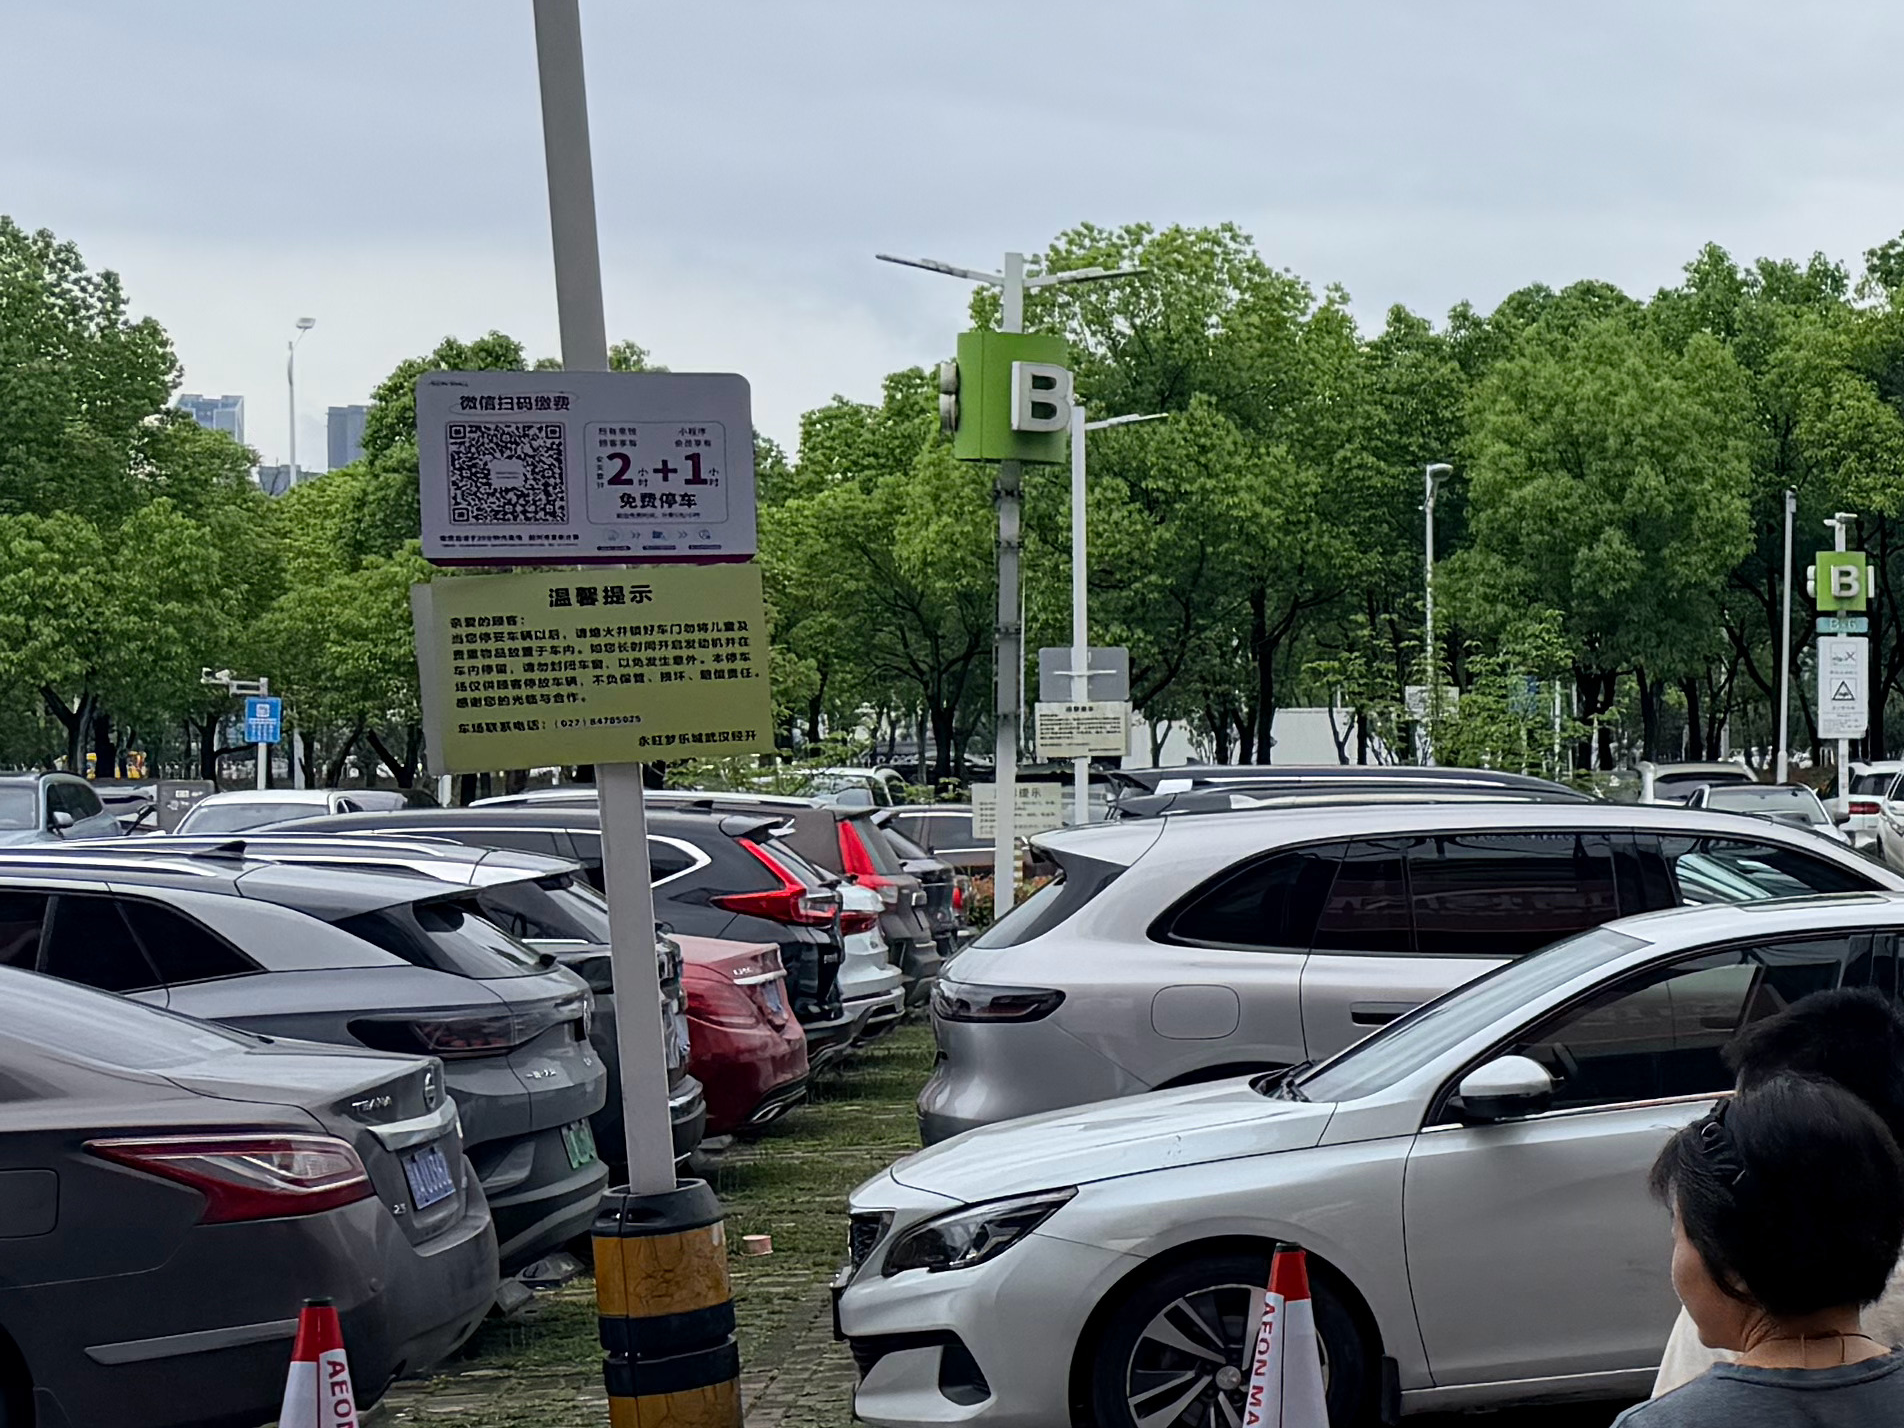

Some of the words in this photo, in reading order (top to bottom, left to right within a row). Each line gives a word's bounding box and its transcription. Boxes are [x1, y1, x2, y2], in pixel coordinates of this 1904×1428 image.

[1011, 361, 1074, 432] B
[619, 492, 698, 509] 免费停车
[549, 584, 653, 607] 温馨提示
[1830, 564, 1861, 598] B
[1252, 1301, 1276, 1377] AEON
